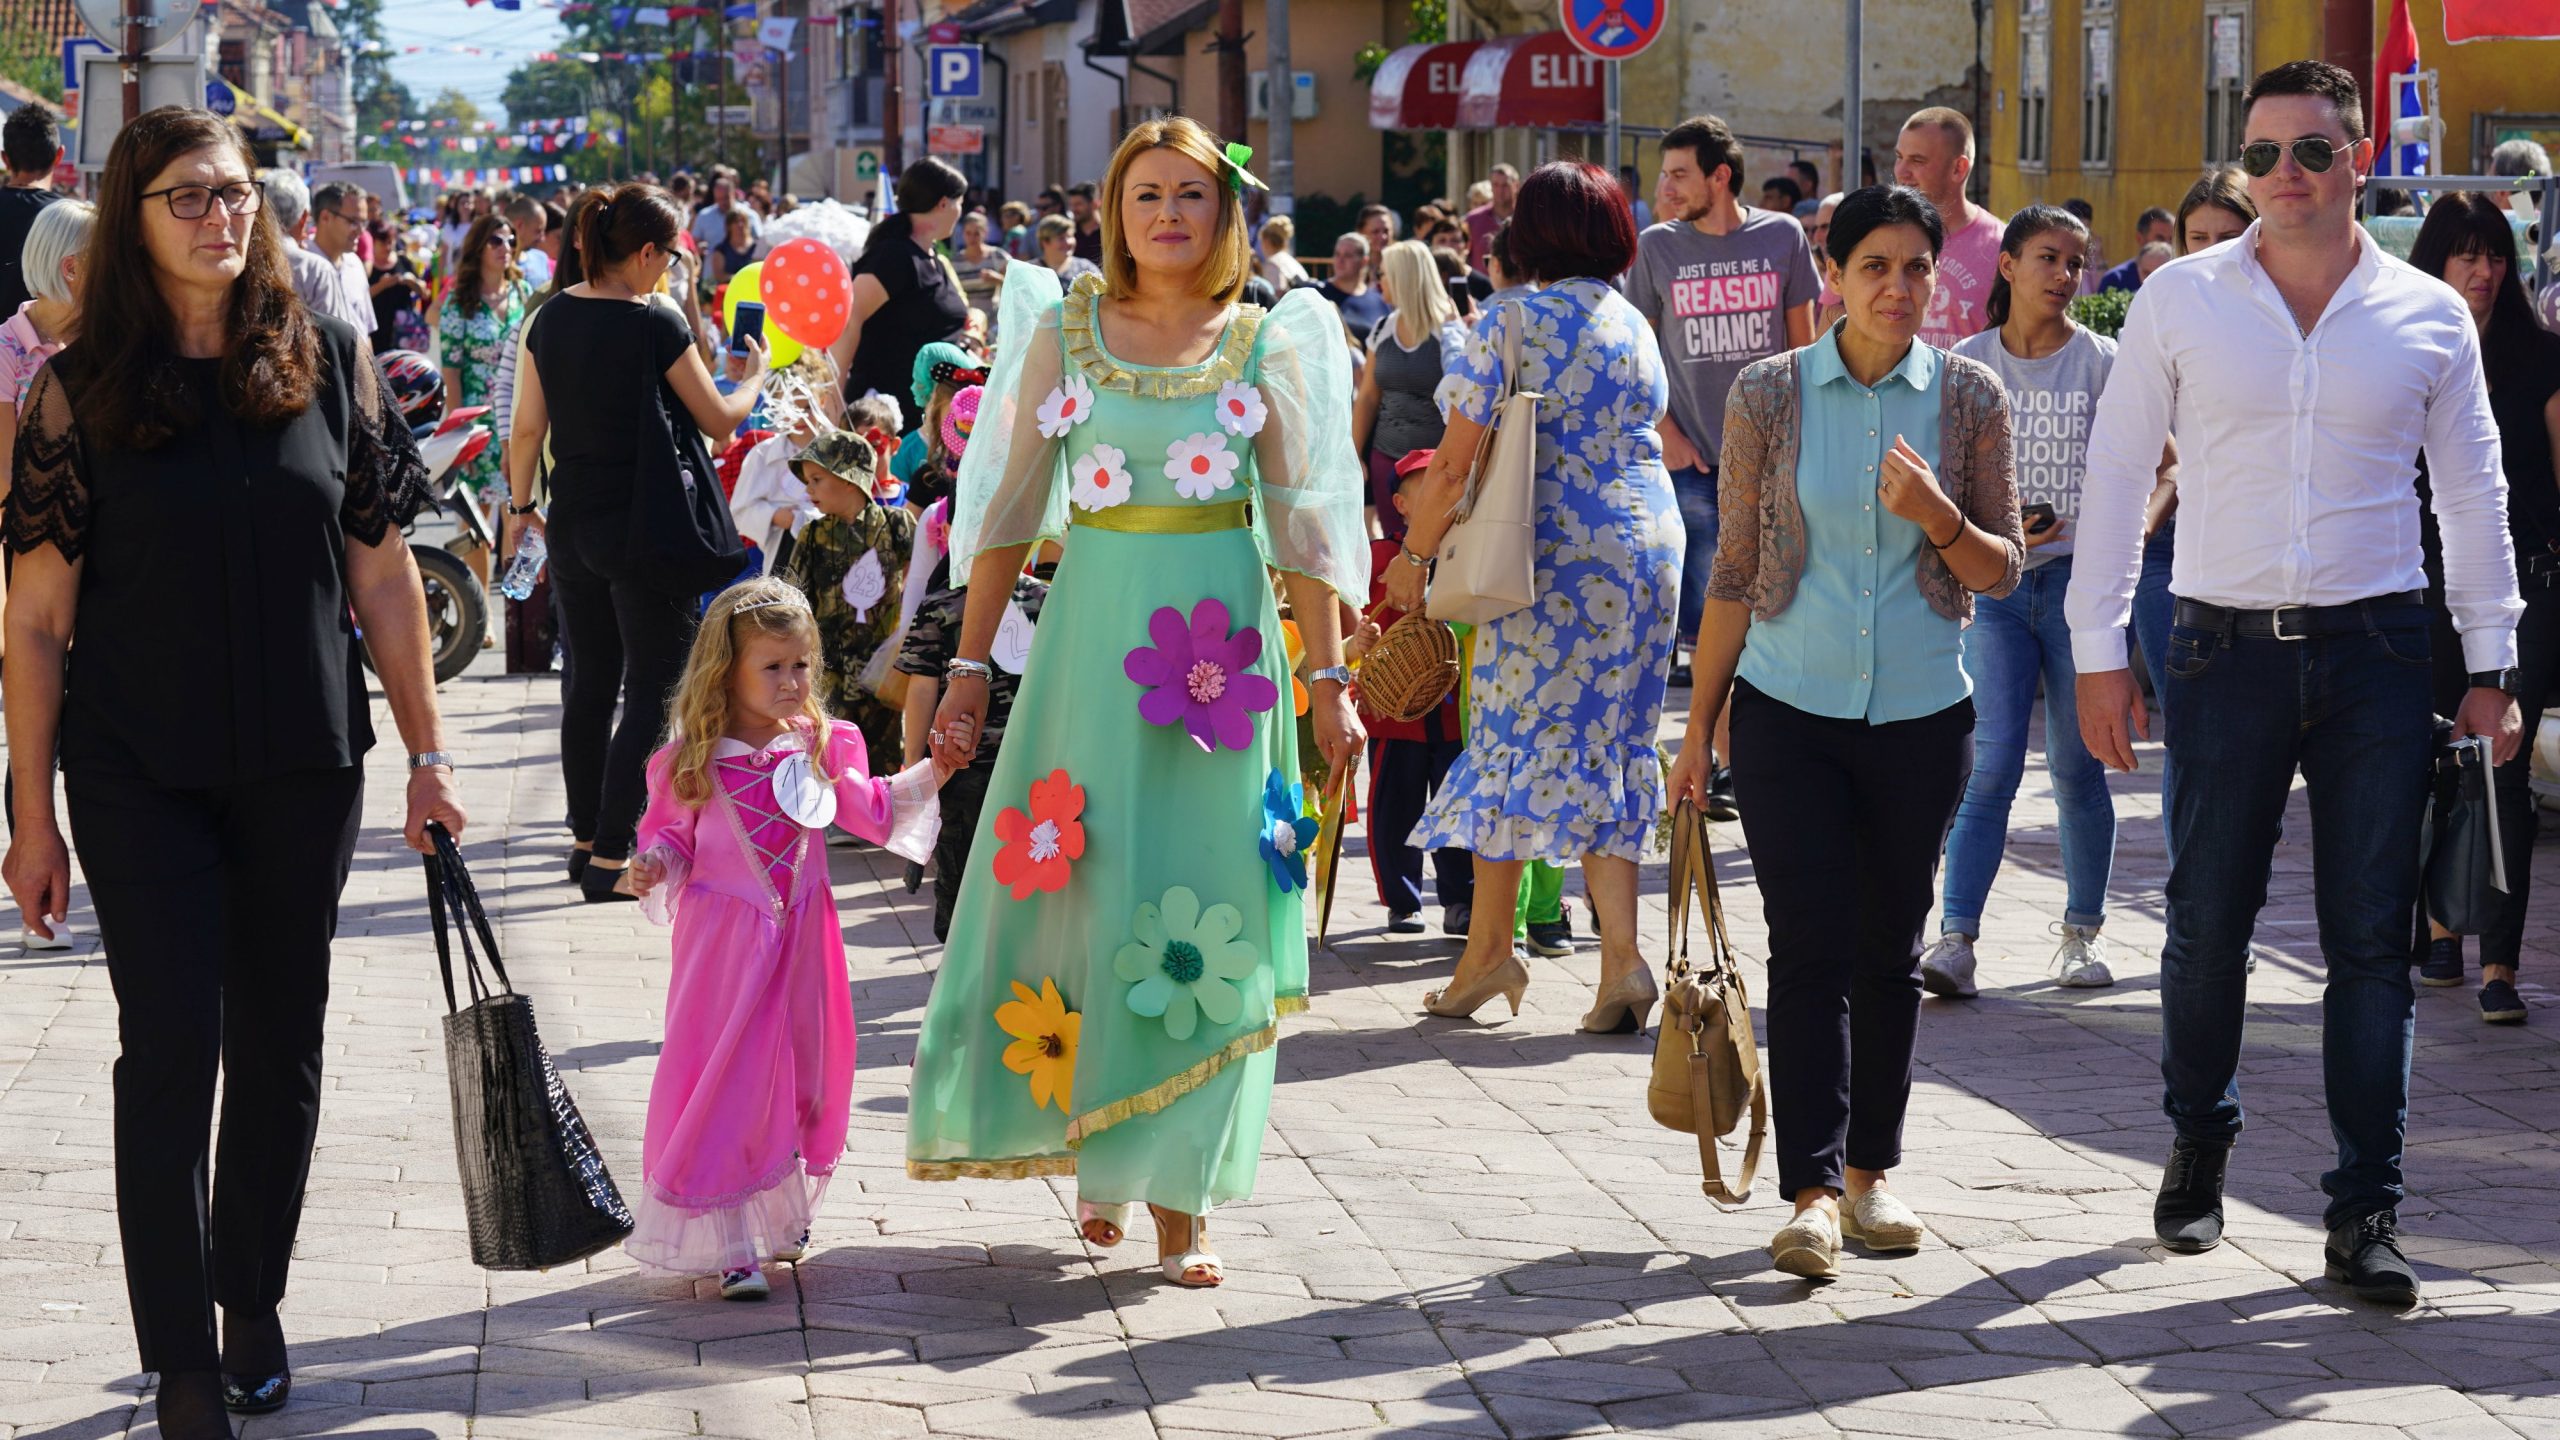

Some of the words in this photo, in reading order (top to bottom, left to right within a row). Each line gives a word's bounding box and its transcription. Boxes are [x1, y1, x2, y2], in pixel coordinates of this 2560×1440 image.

[940, 52, 970, 92] P
[1429, 62, 1462, 93] EL
[1531, 54, 1597, 88] ELIT
[1676, 263, 1707, 280] JUST
[1710, 261, 1739, 277] GIVE
[1742, 259, 1759, 274] ME
[1763, 258, 1772, 272] A
[1672, 274, 1778, 316] REASON
[1685, 311, 1772, 356] CHANCE
[1712, 353, 1724, 363] TO
[1725, 351, 1751, 362] WORLD
[2006, 389, 2089, 414] NJOUR
[2011, 414, 2087, 439] NJOUR
[2018, 465, 2085, 490] JOUR
[850, 566, 880, 598] 23
